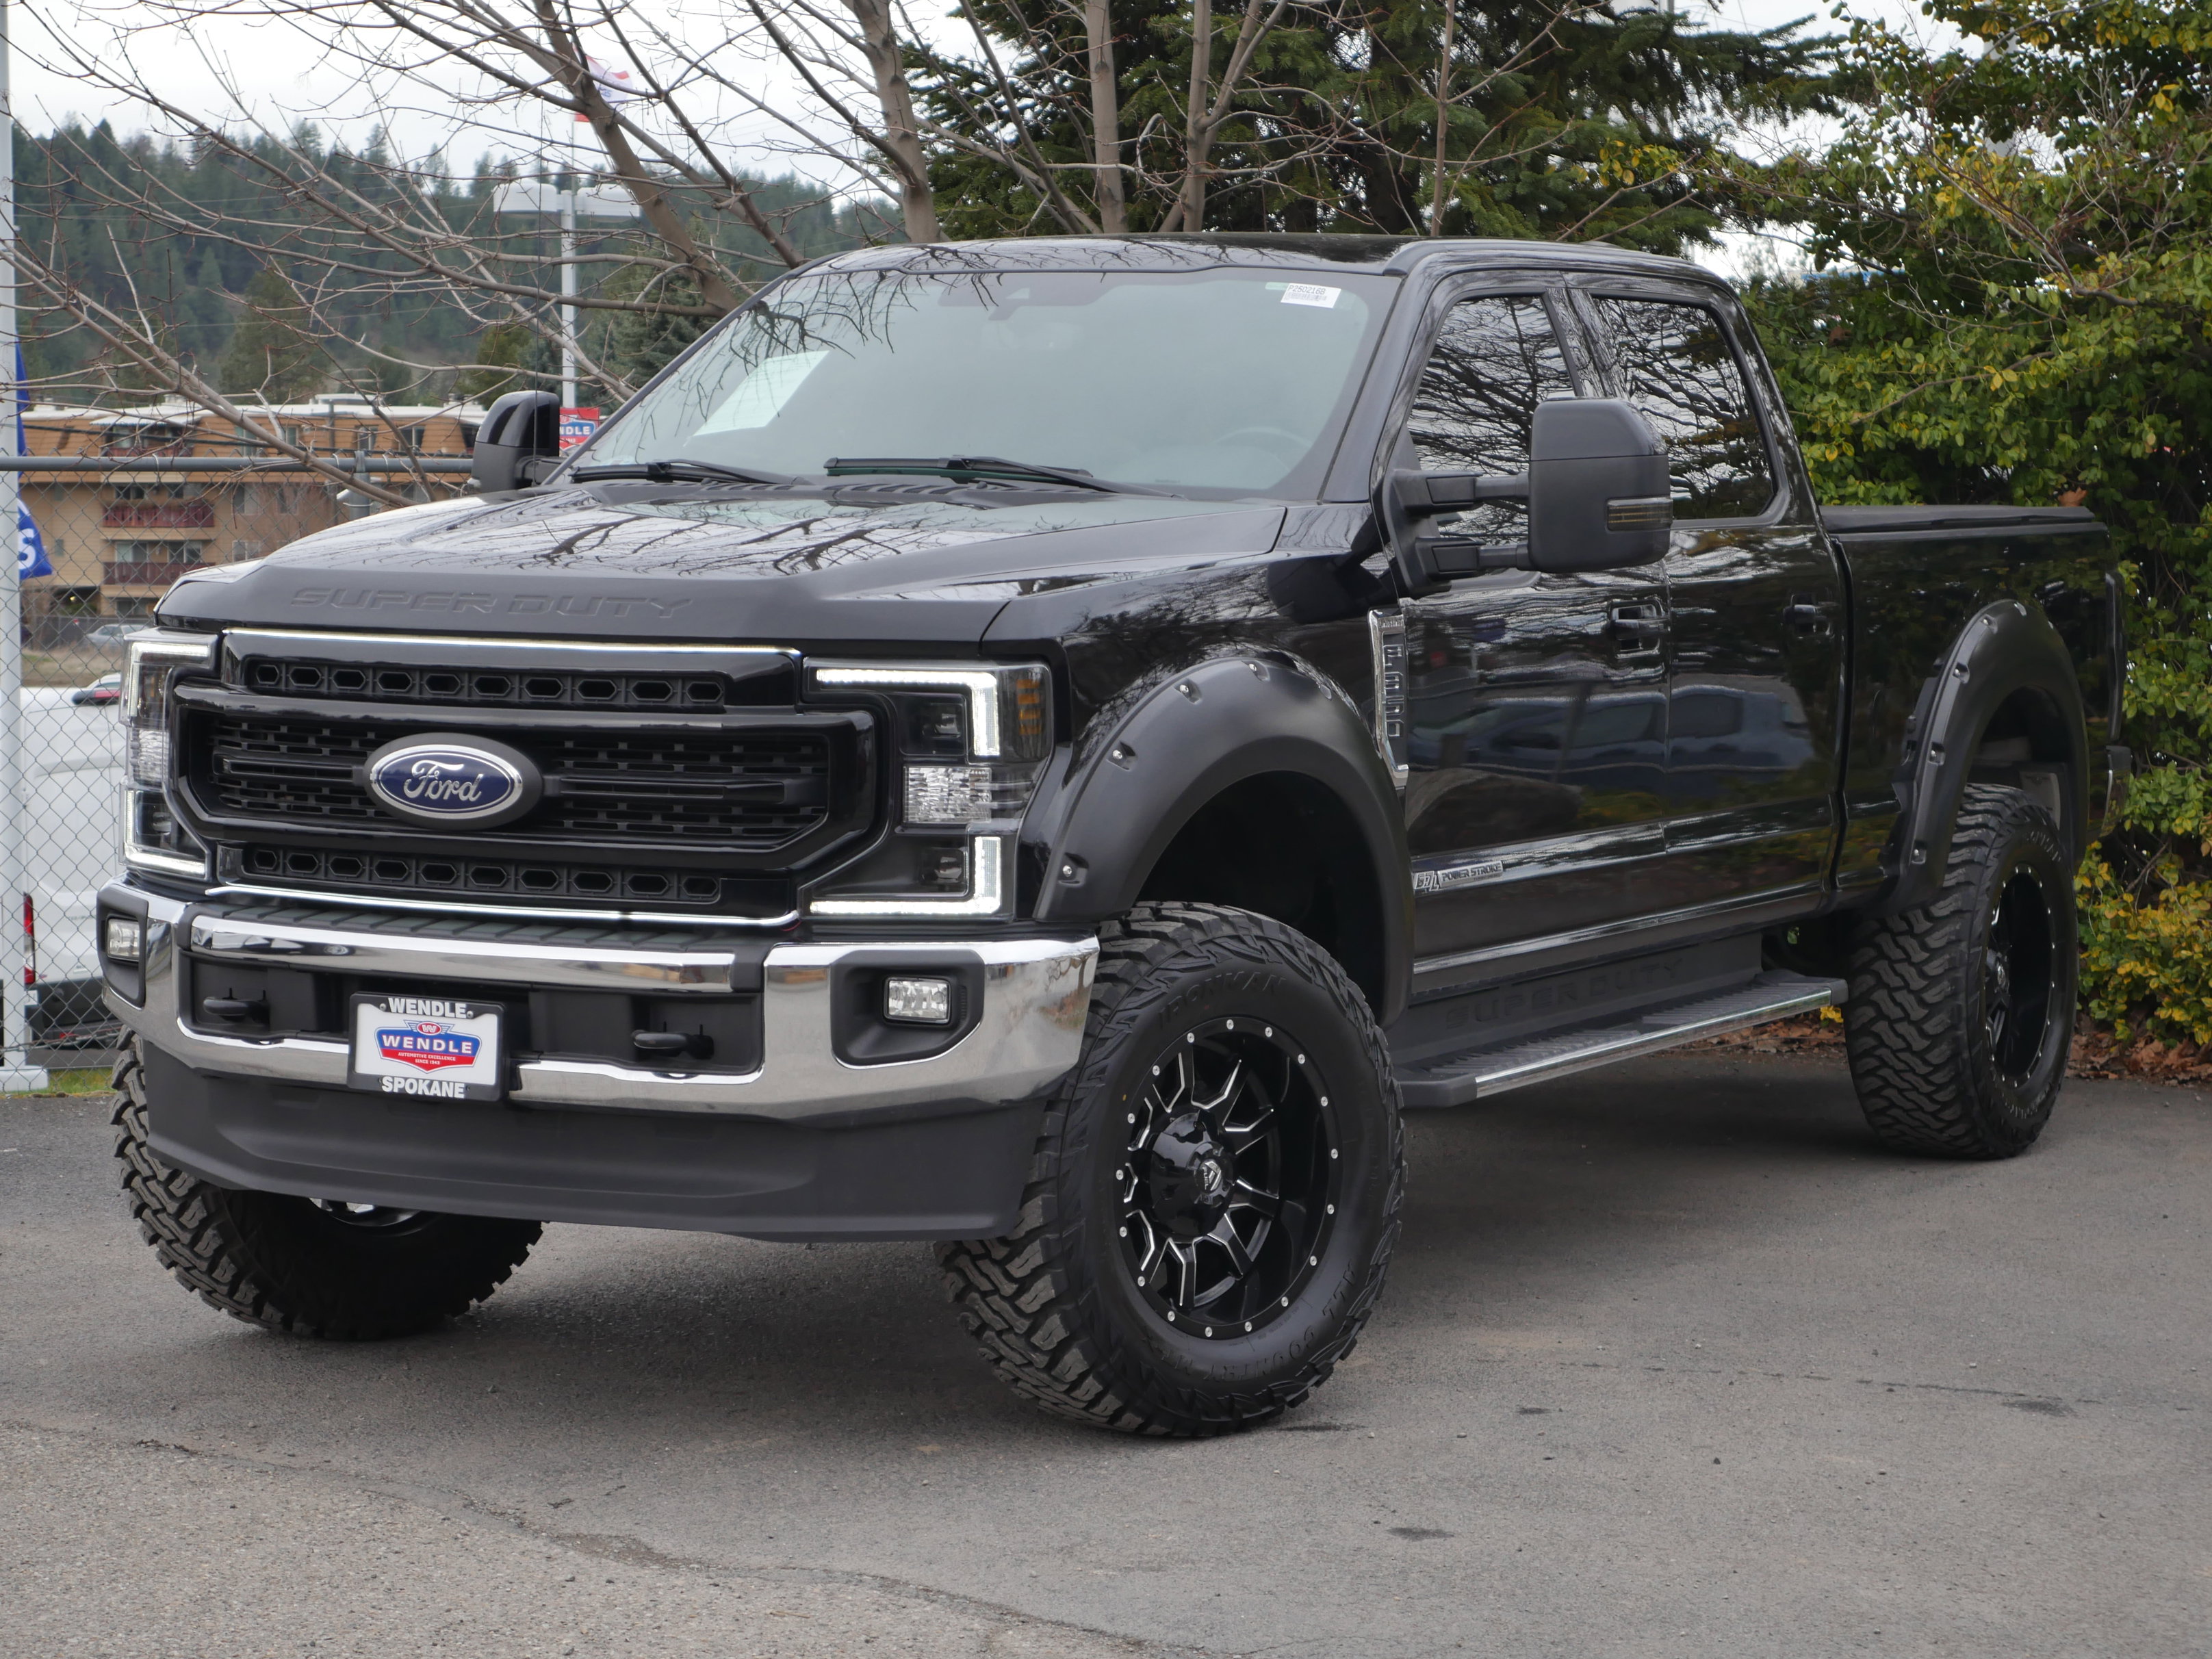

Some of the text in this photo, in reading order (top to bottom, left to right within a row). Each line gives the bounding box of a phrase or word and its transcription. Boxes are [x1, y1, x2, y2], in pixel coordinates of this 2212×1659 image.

[291, 587, 693, 619] SUPER DUTY
[403, 759, 484, 802] Ford
[1441, 869, 1470, 882] POWER
[1471, 862, 1502, 877] STROKE
[1445, 957, 1684, 1031] SUPER DUTY
[387, 997, 467, 1019] WENDLE
[382, 1035, 472, 1054] WENDLE
[382, 1076, 465, 1098] SPOKANE
